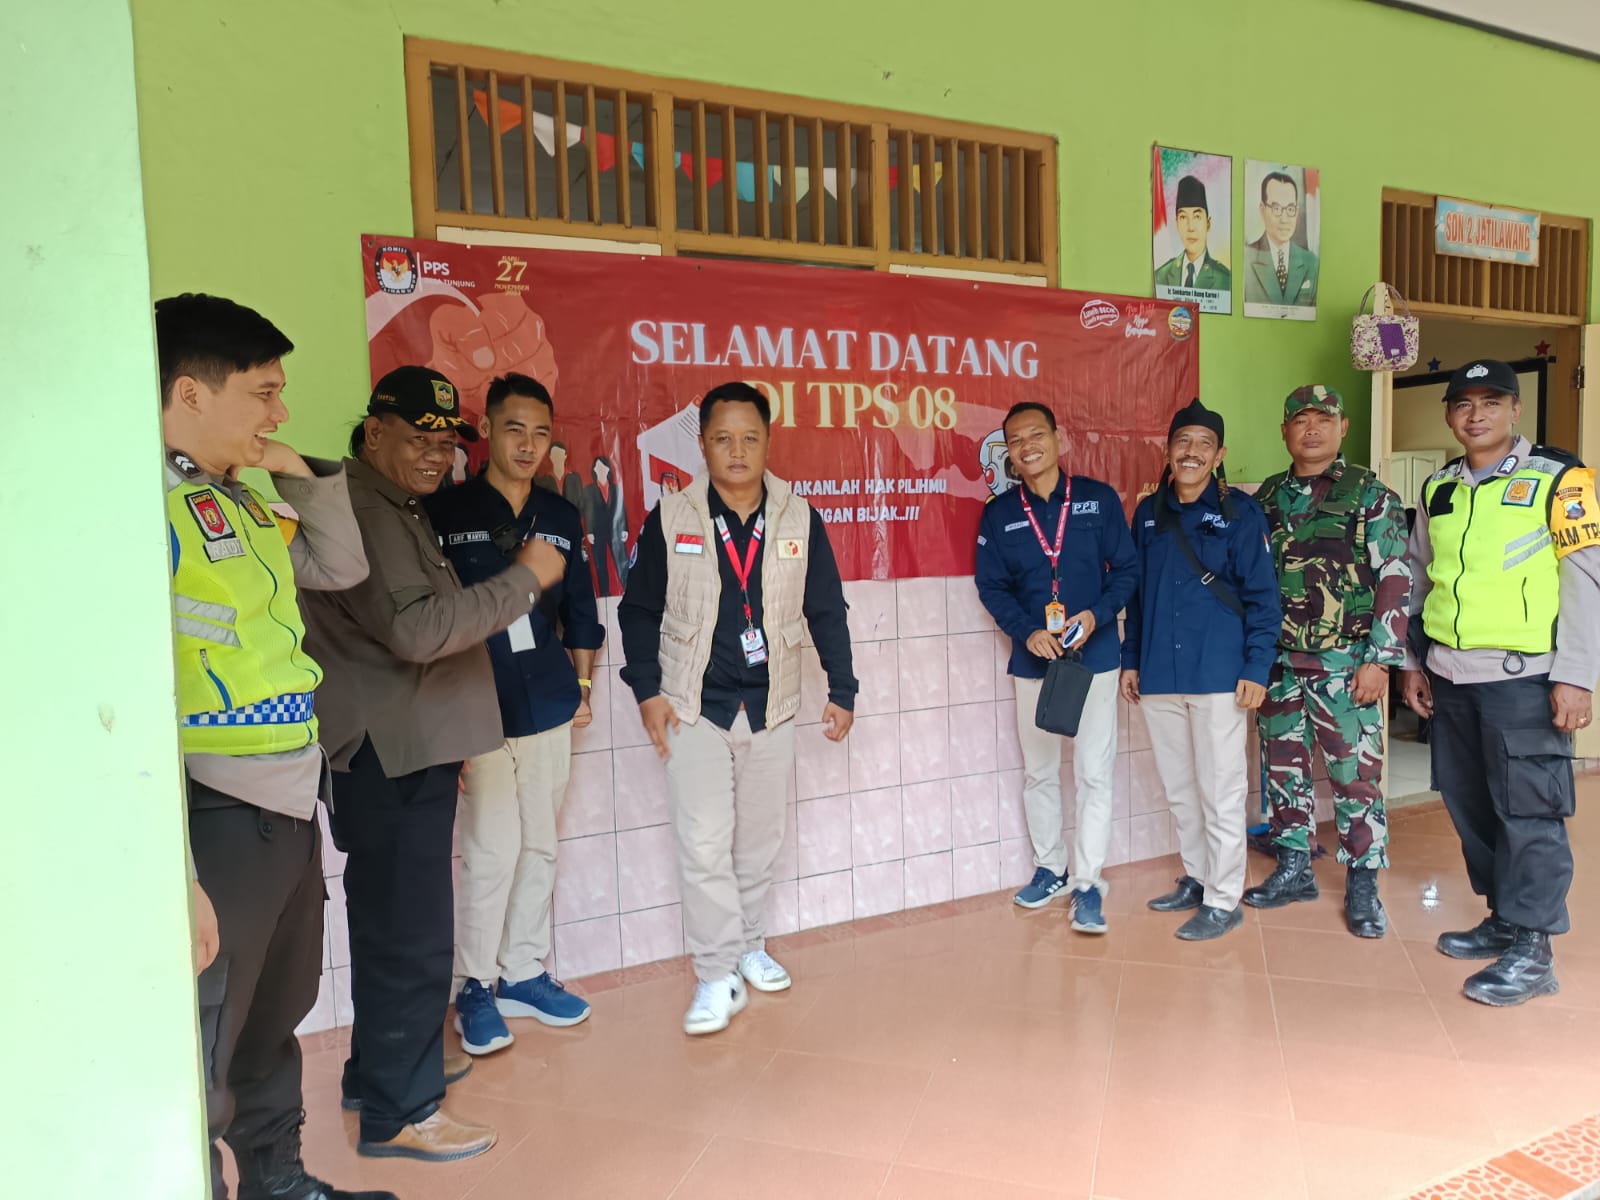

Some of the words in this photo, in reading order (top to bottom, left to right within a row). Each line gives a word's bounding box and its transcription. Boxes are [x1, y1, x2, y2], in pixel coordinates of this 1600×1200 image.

[1445, 211, 1465, 243] SDN
[1467, 215, 1473, 244] 2
[1475, 218, 1531, 253] JATILAWANG
[423, 260, 450, 276] PPS
[495, 260, 528, 282] 27
[494, 283, 530, 292] NOVEMBER
[630, 319, 858, 370] SELAMAT
[868, 331, 1040, 380] DATANG
[745, 380, 797, 428] DI
[806, 381, 899, 429] TPS
[908, 385, 958, 430] 08
[864, 478, 895, 495] HAK
[897, 478, 947, 494] PILIHMU
[1551, 526, 1581, 549] PAM
[1581, 522, 1600, 540] TP
